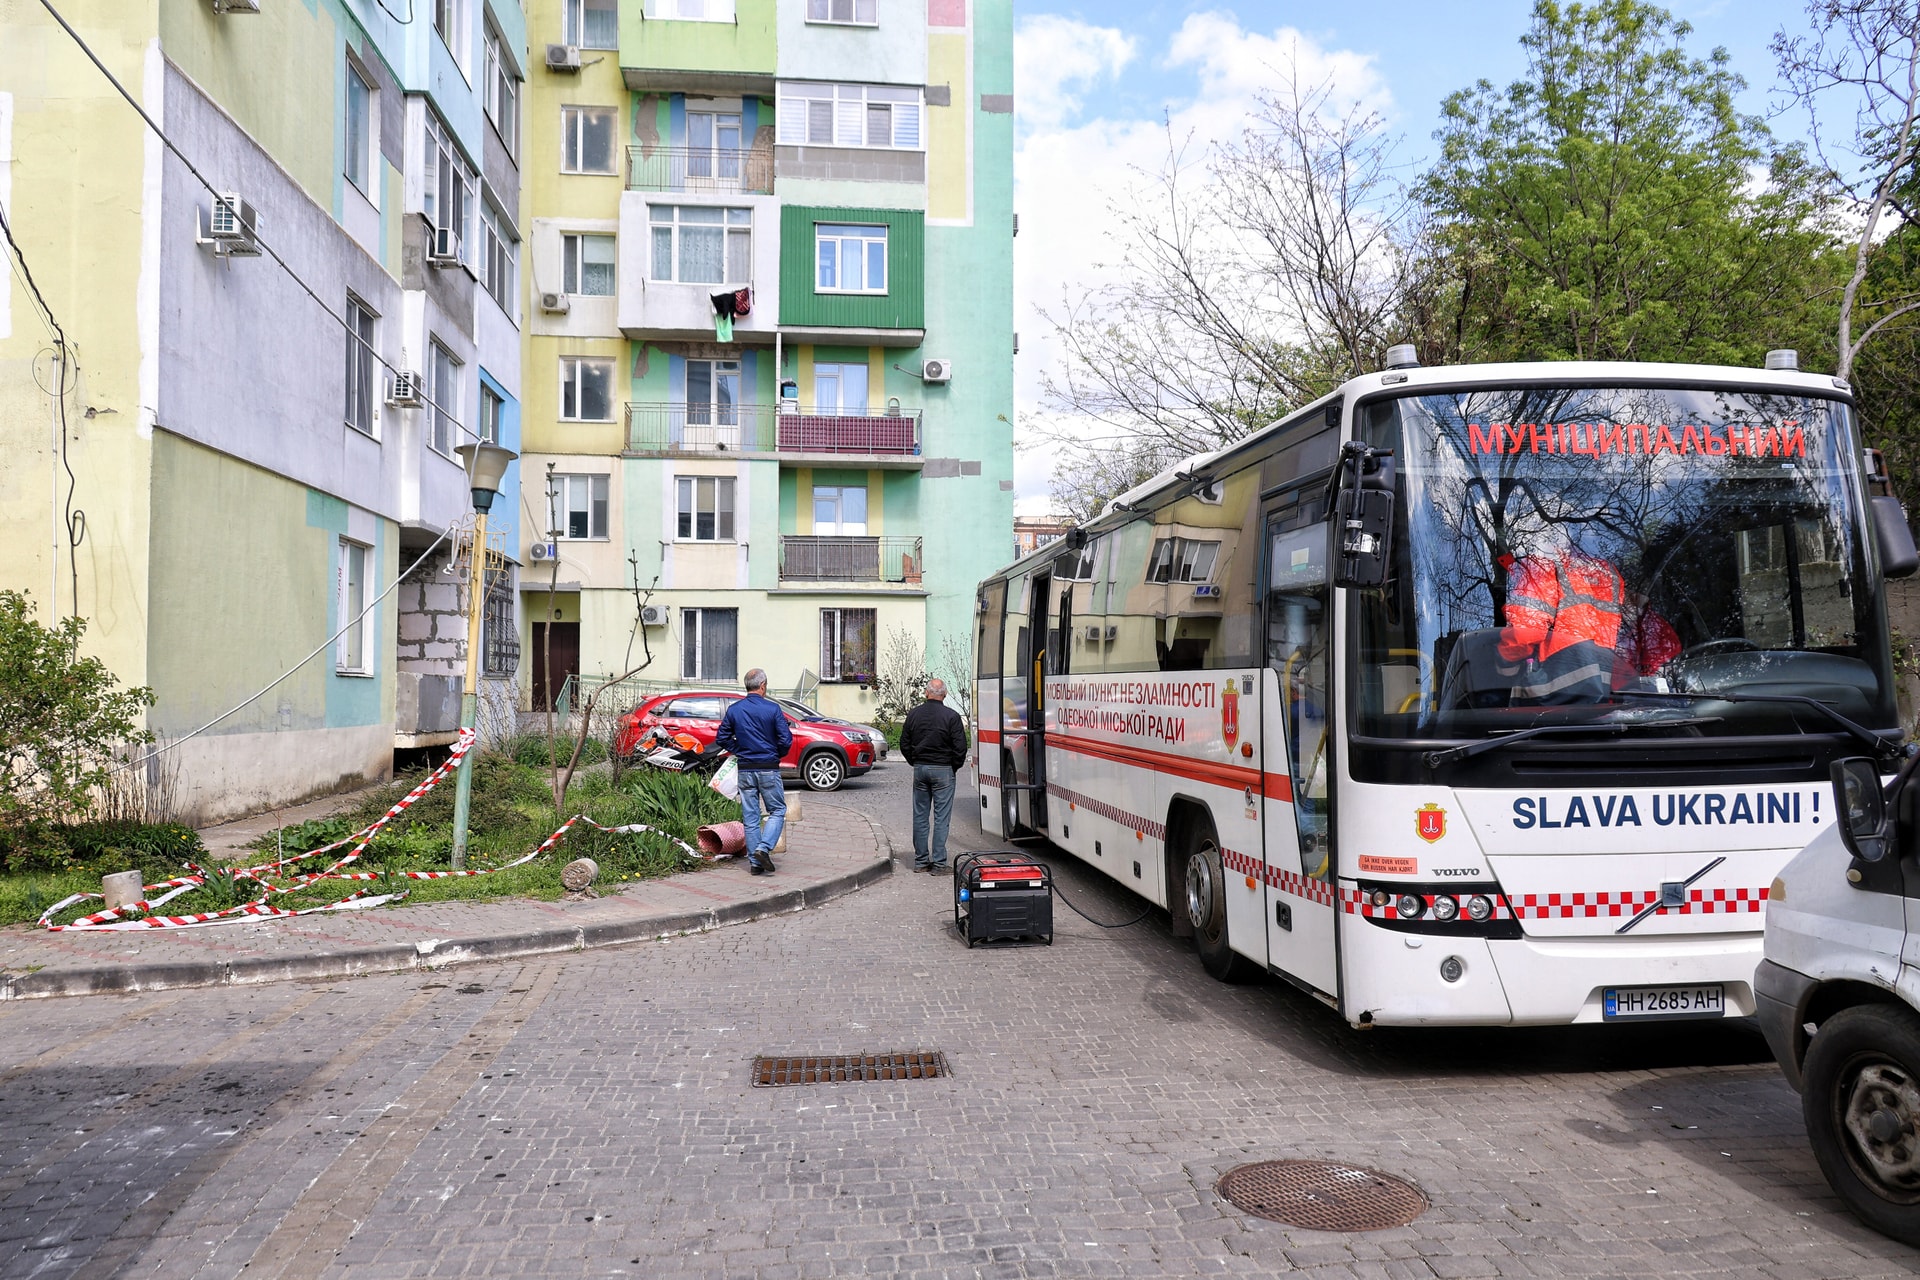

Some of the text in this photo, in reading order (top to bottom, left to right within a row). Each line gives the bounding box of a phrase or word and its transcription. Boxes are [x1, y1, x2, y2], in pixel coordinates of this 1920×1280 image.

[1469, 421, 1806, 460] МУНІЦИПАЛЬНИЙ
[1046, 679, 1215, 708] МОБІЛЬНИЙ ПУНКТ НЕЗЛАМНОСТІ
[1057, 705, 1185, 745] ОДЕСЬКОЇ МІСЬКОЇ РАДИ
[1512, 795, 1642, 829] SLAVA
[1652, 791, 1800, 826] UKRAINI
[1432, 868, 1480, 877] VOLVO
[1617, 989, 1720, 1012] HH 2685 AH
